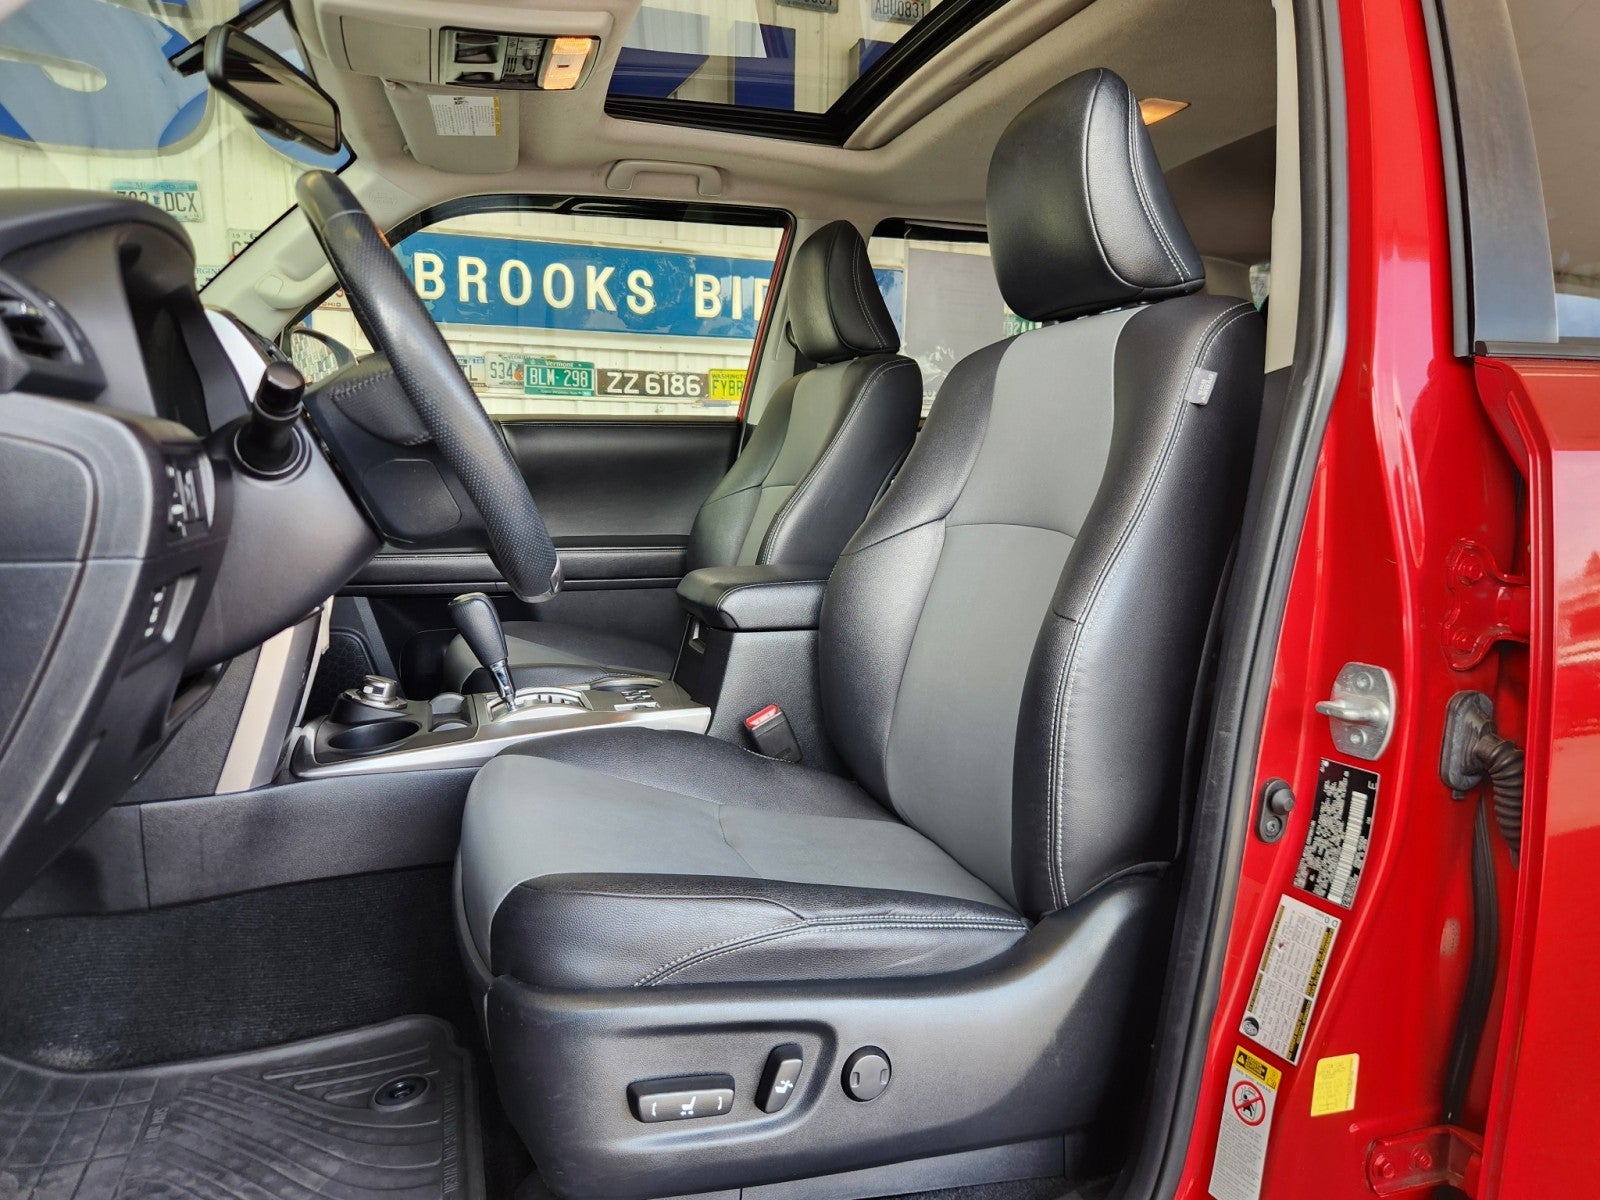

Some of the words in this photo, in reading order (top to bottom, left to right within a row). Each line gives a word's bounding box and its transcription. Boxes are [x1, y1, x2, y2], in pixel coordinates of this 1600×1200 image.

[164, 191, 197, 212] DCX
[413, 251, 656, 316] BROOKS
[545, 360, 574, 369] Vermont
[606, 371, 640, 395] ZZ
[645, 373, 701, 396] 6186
